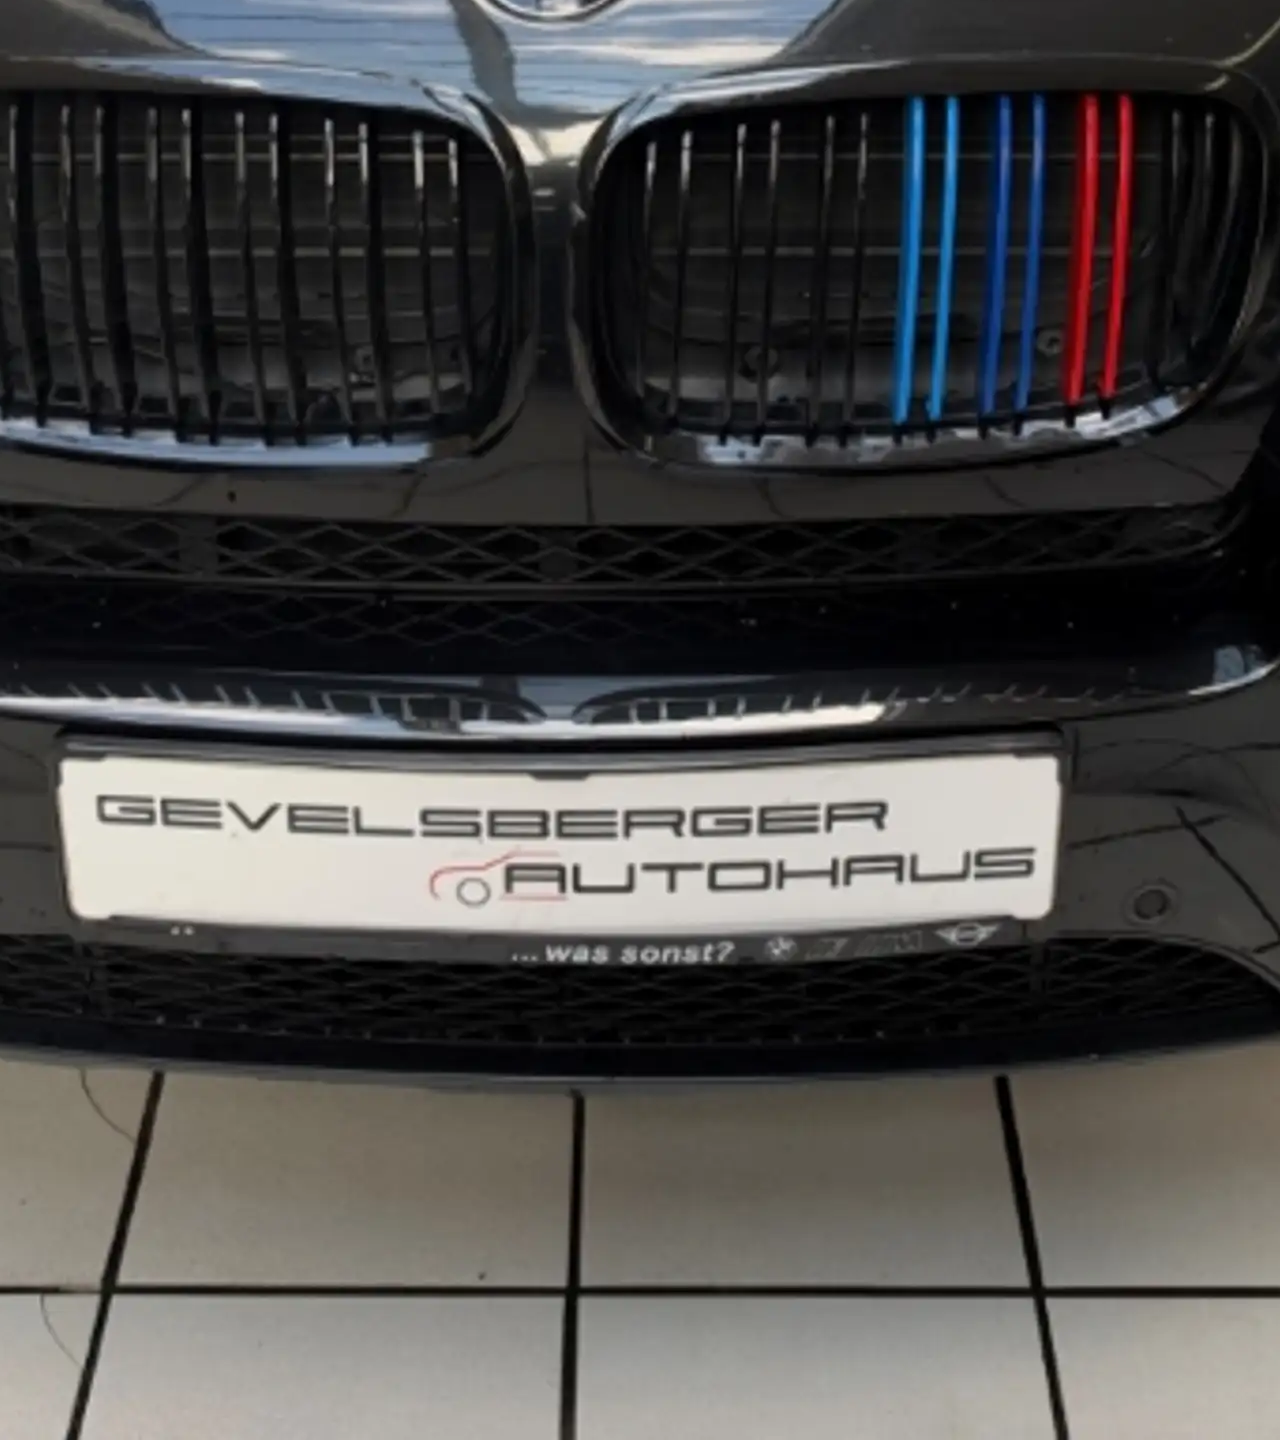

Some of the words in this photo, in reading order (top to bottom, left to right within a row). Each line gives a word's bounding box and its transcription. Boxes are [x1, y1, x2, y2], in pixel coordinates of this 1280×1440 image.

[95, 793, 890, 840] GEVELSBERGER
[503, 847, 1037, 894] AUTOHAUS
[620, 940, 736, 965] sonst?
